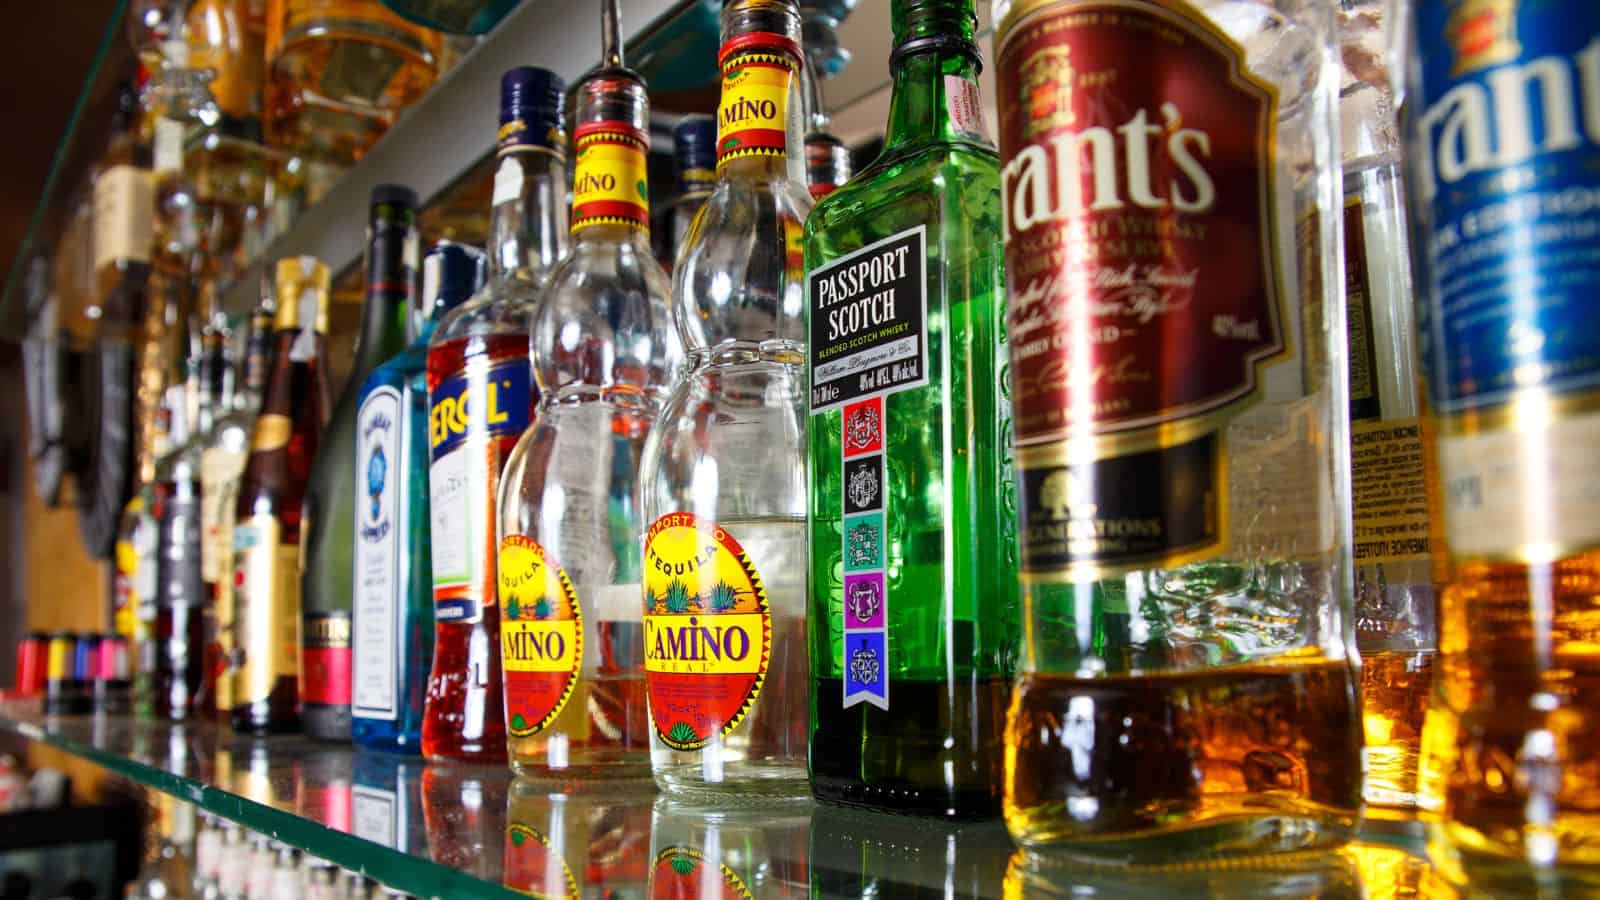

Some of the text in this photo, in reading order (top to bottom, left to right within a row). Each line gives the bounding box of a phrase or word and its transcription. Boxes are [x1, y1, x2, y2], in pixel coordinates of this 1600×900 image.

[818, 245, 910, 310] PASSPORT
[828, 288, 897, 341] SCOTCH
[818, 322, 911, 360] BLENDED SCOTCH WHISKY
[650, 545, 717, 577] TEQUILA
[644, 616, 751, 662] CAMINO
